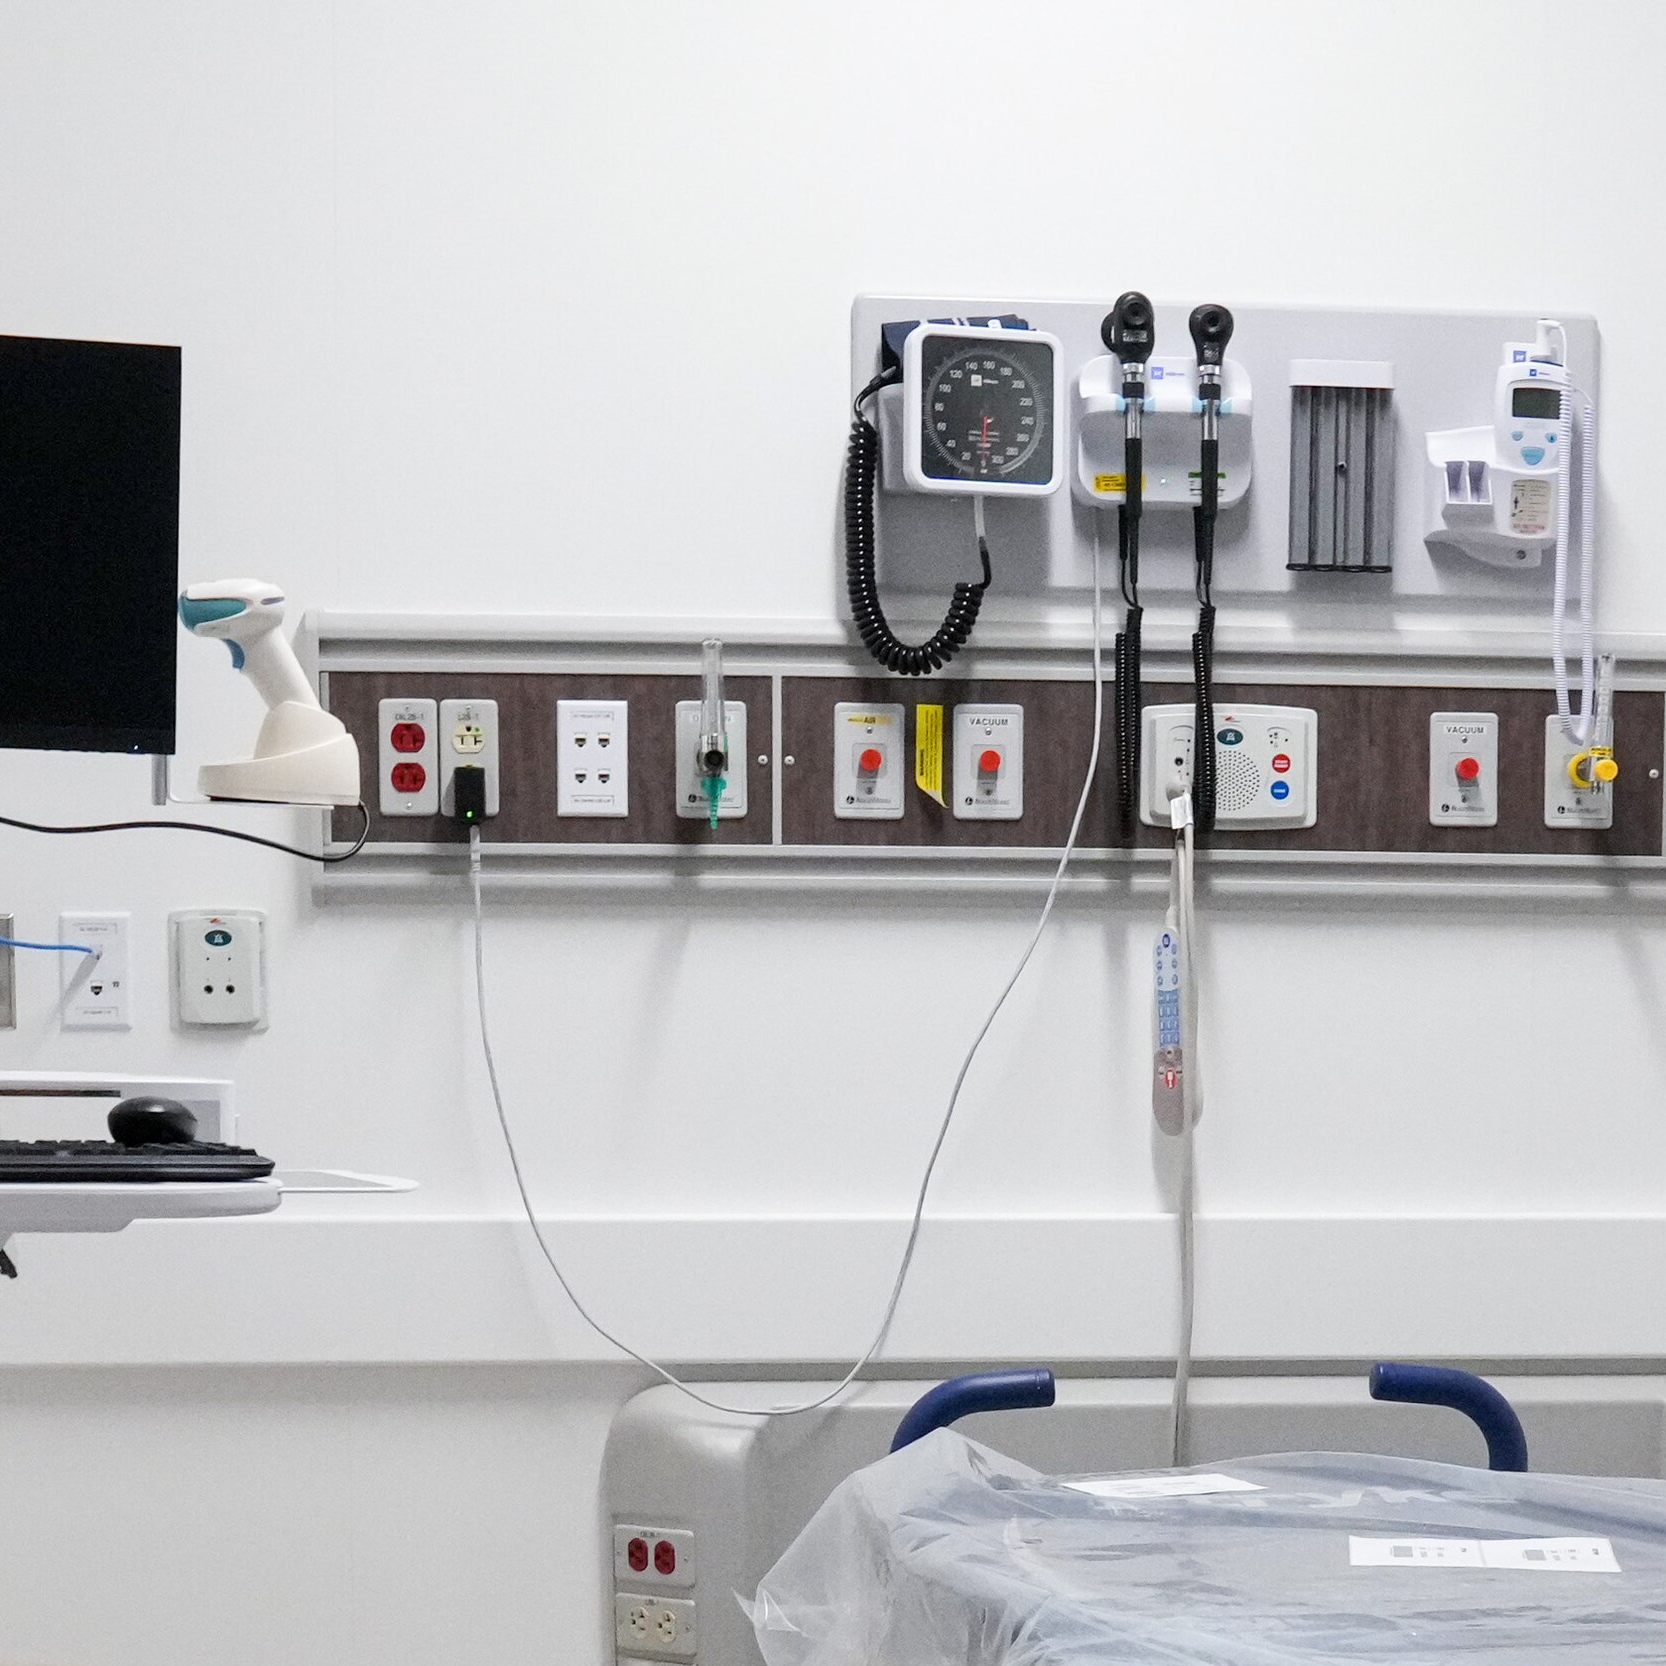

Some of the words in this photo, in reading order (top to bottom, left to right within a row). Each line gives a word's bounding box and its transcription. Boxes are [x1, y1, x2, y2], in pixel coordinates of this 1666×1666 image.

[965, 362, 978, 371] 140
[949, 369, 963, 379] 120
[969, 717, 1009, 726] VACUUM
[1445, 726, 1485, 734] VACUUM
